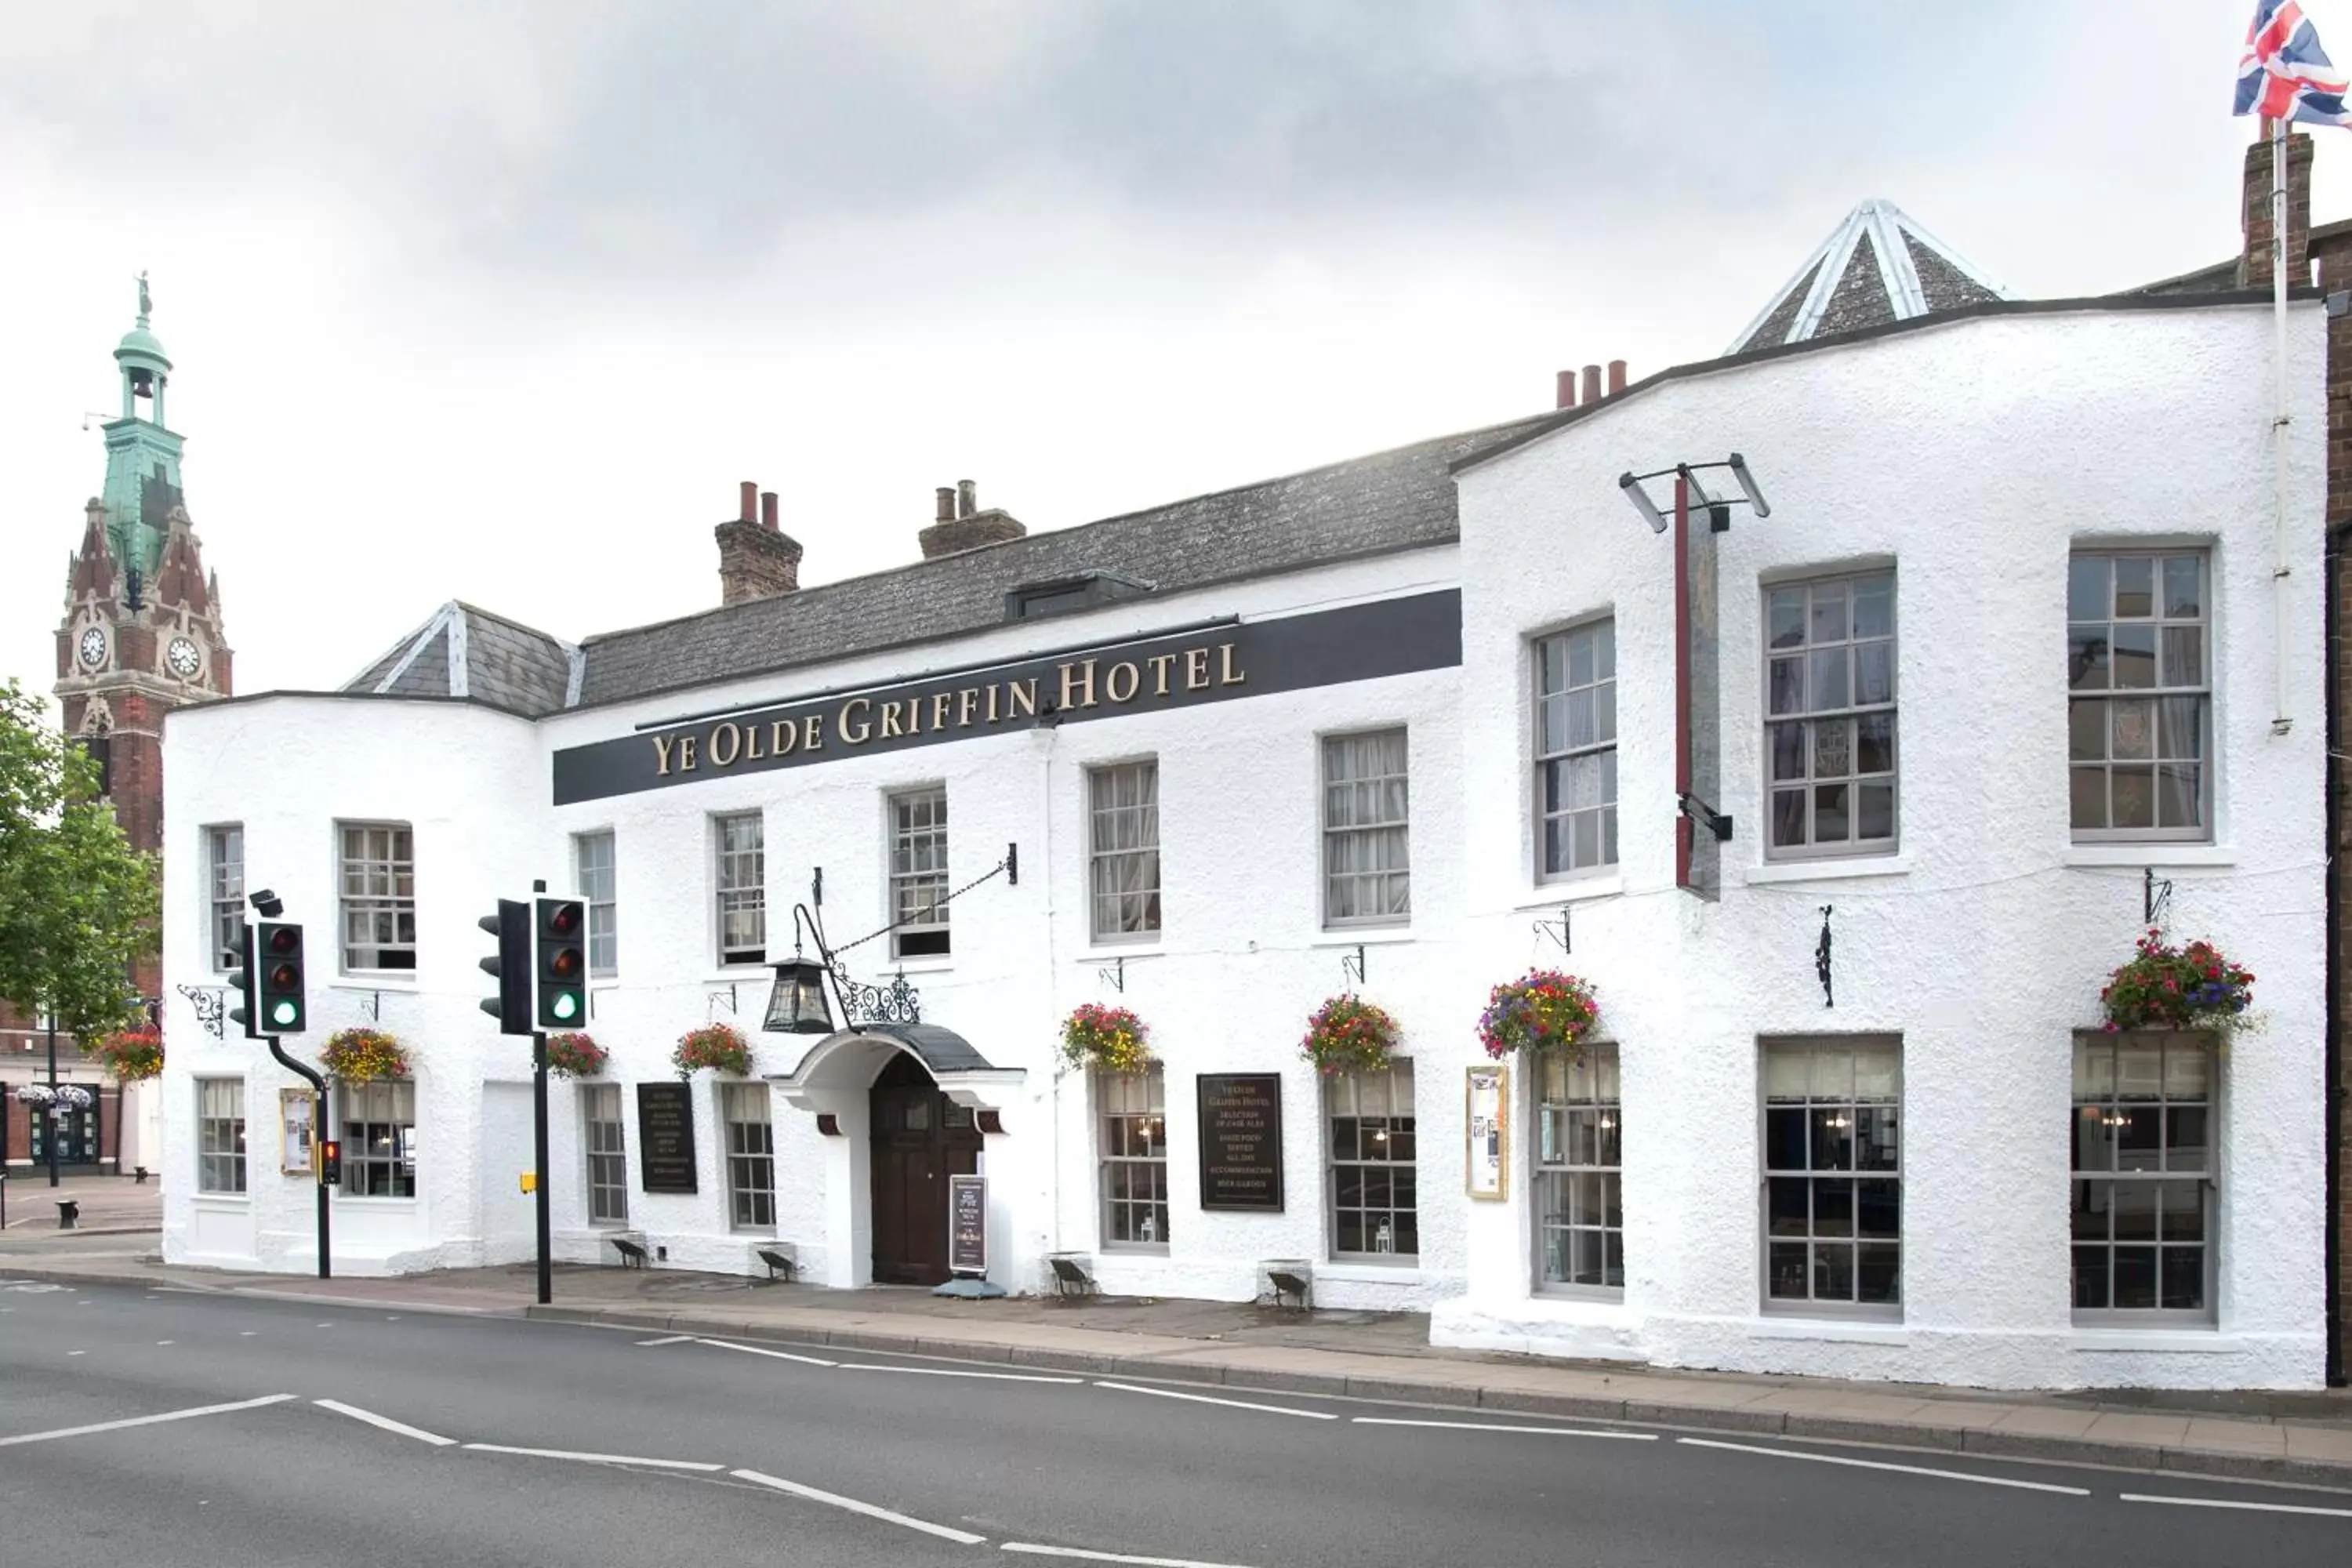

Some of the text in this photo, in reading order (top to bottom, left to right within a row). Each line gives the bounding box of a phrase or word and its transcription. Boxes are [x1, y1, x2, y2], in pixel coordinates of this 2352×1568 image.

[652, 644, 1245, 775] YE OLDE GRIFFIN HOTEL
